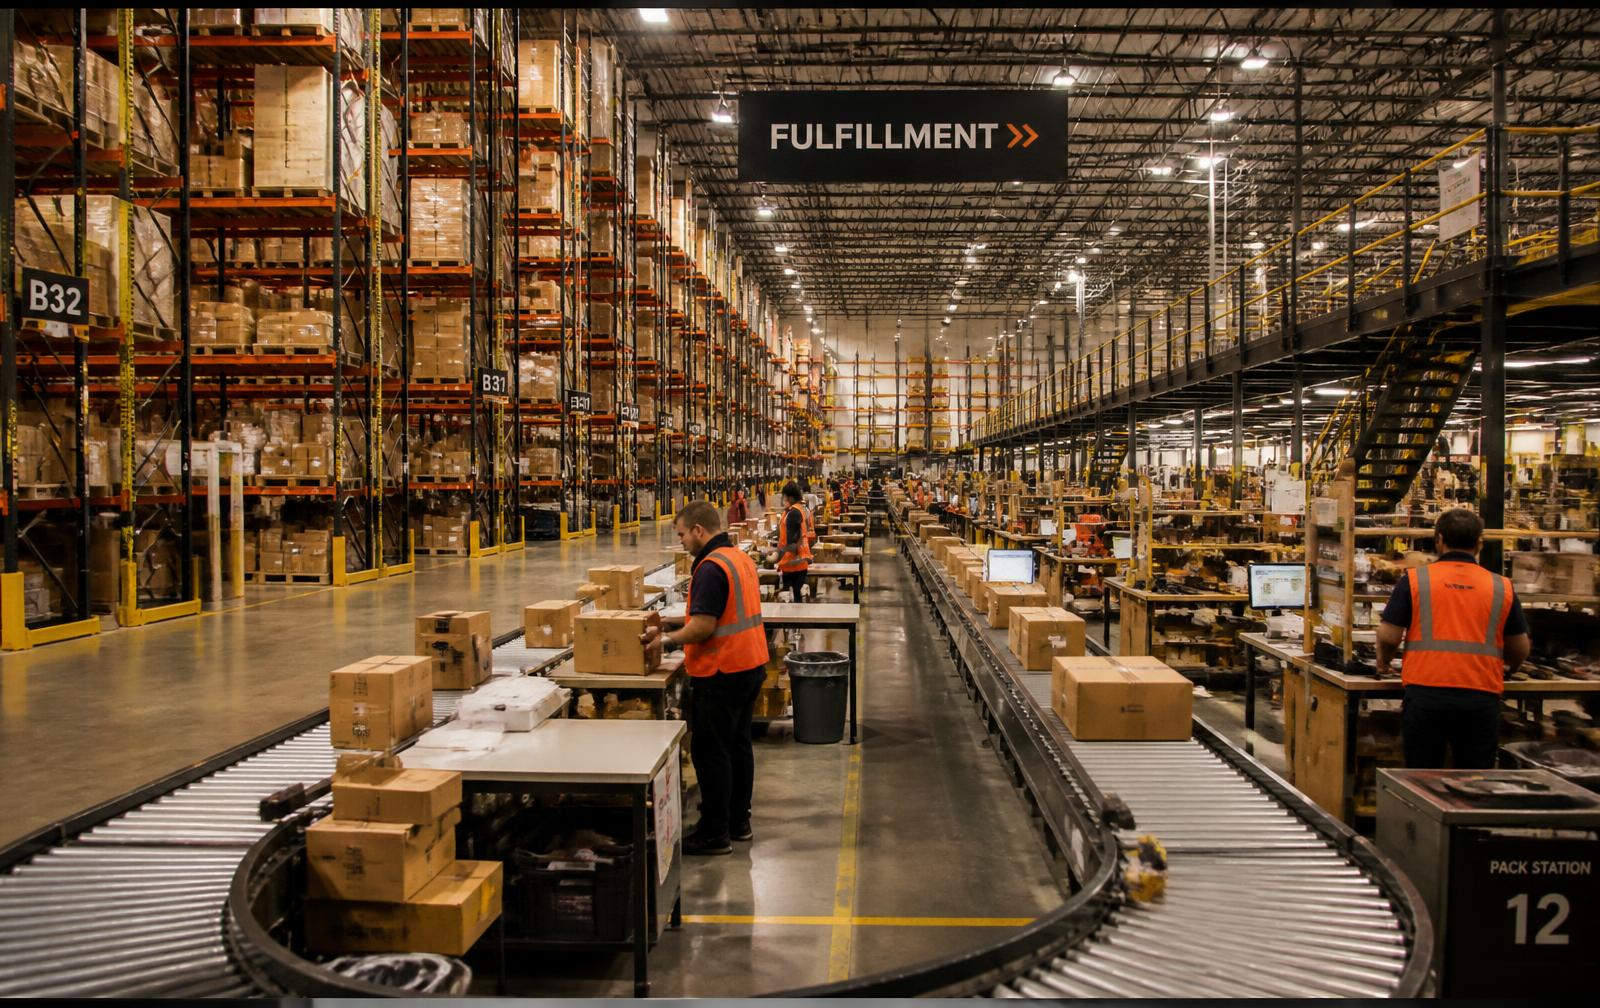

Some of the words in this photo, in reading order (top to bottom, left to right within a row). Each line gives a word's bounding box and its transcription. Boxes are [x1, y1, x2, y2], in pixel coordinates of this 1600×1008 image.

[771, 123, 998, 150] FULFILLMENT
[29, 279, 81, 316] B32
[482, 374, 506, 393] B31
[1490, 860, 1528, 874] PACK
[1532, 860, 1591, 875] STATION
[1506, 893, 1570, 945] 12
